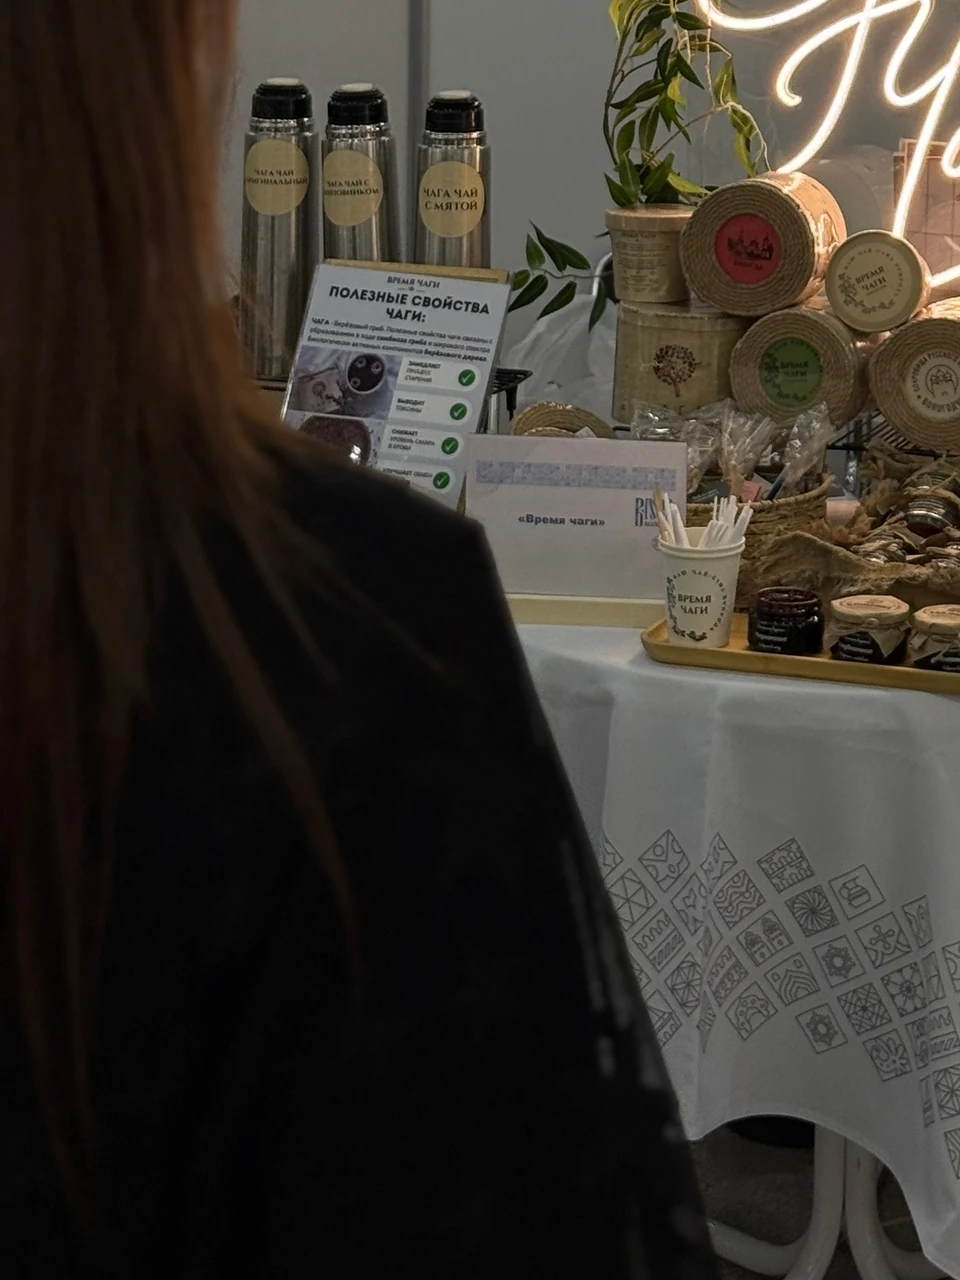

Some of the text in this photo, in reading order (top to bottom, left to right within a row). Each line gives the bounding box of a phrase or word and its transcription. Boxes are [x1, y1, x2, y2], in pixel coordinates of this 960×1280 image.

[424, 187, 478, 198] ЧАГА ЧАЙ
[425, 200, 478, 211] С МЯТОЙ
[855, 265, 885, 285] ВРЕМЯ
[387, 276, 440, 289] ВРЕМЯ ЧАГИ
[861, 276, 887, 291] ЧАГИ
[329, 285, 490, 315] ПОЛЕЗНЫЕ СВОЙСТВА
[386, 307, 426, 323] ЧАГИ:
[518, 513, 605, 526] «Время чаги»
[677, 594, 712, 603] ВРЕМЯ
[680, 605, 708, 615] ЧАГИ
